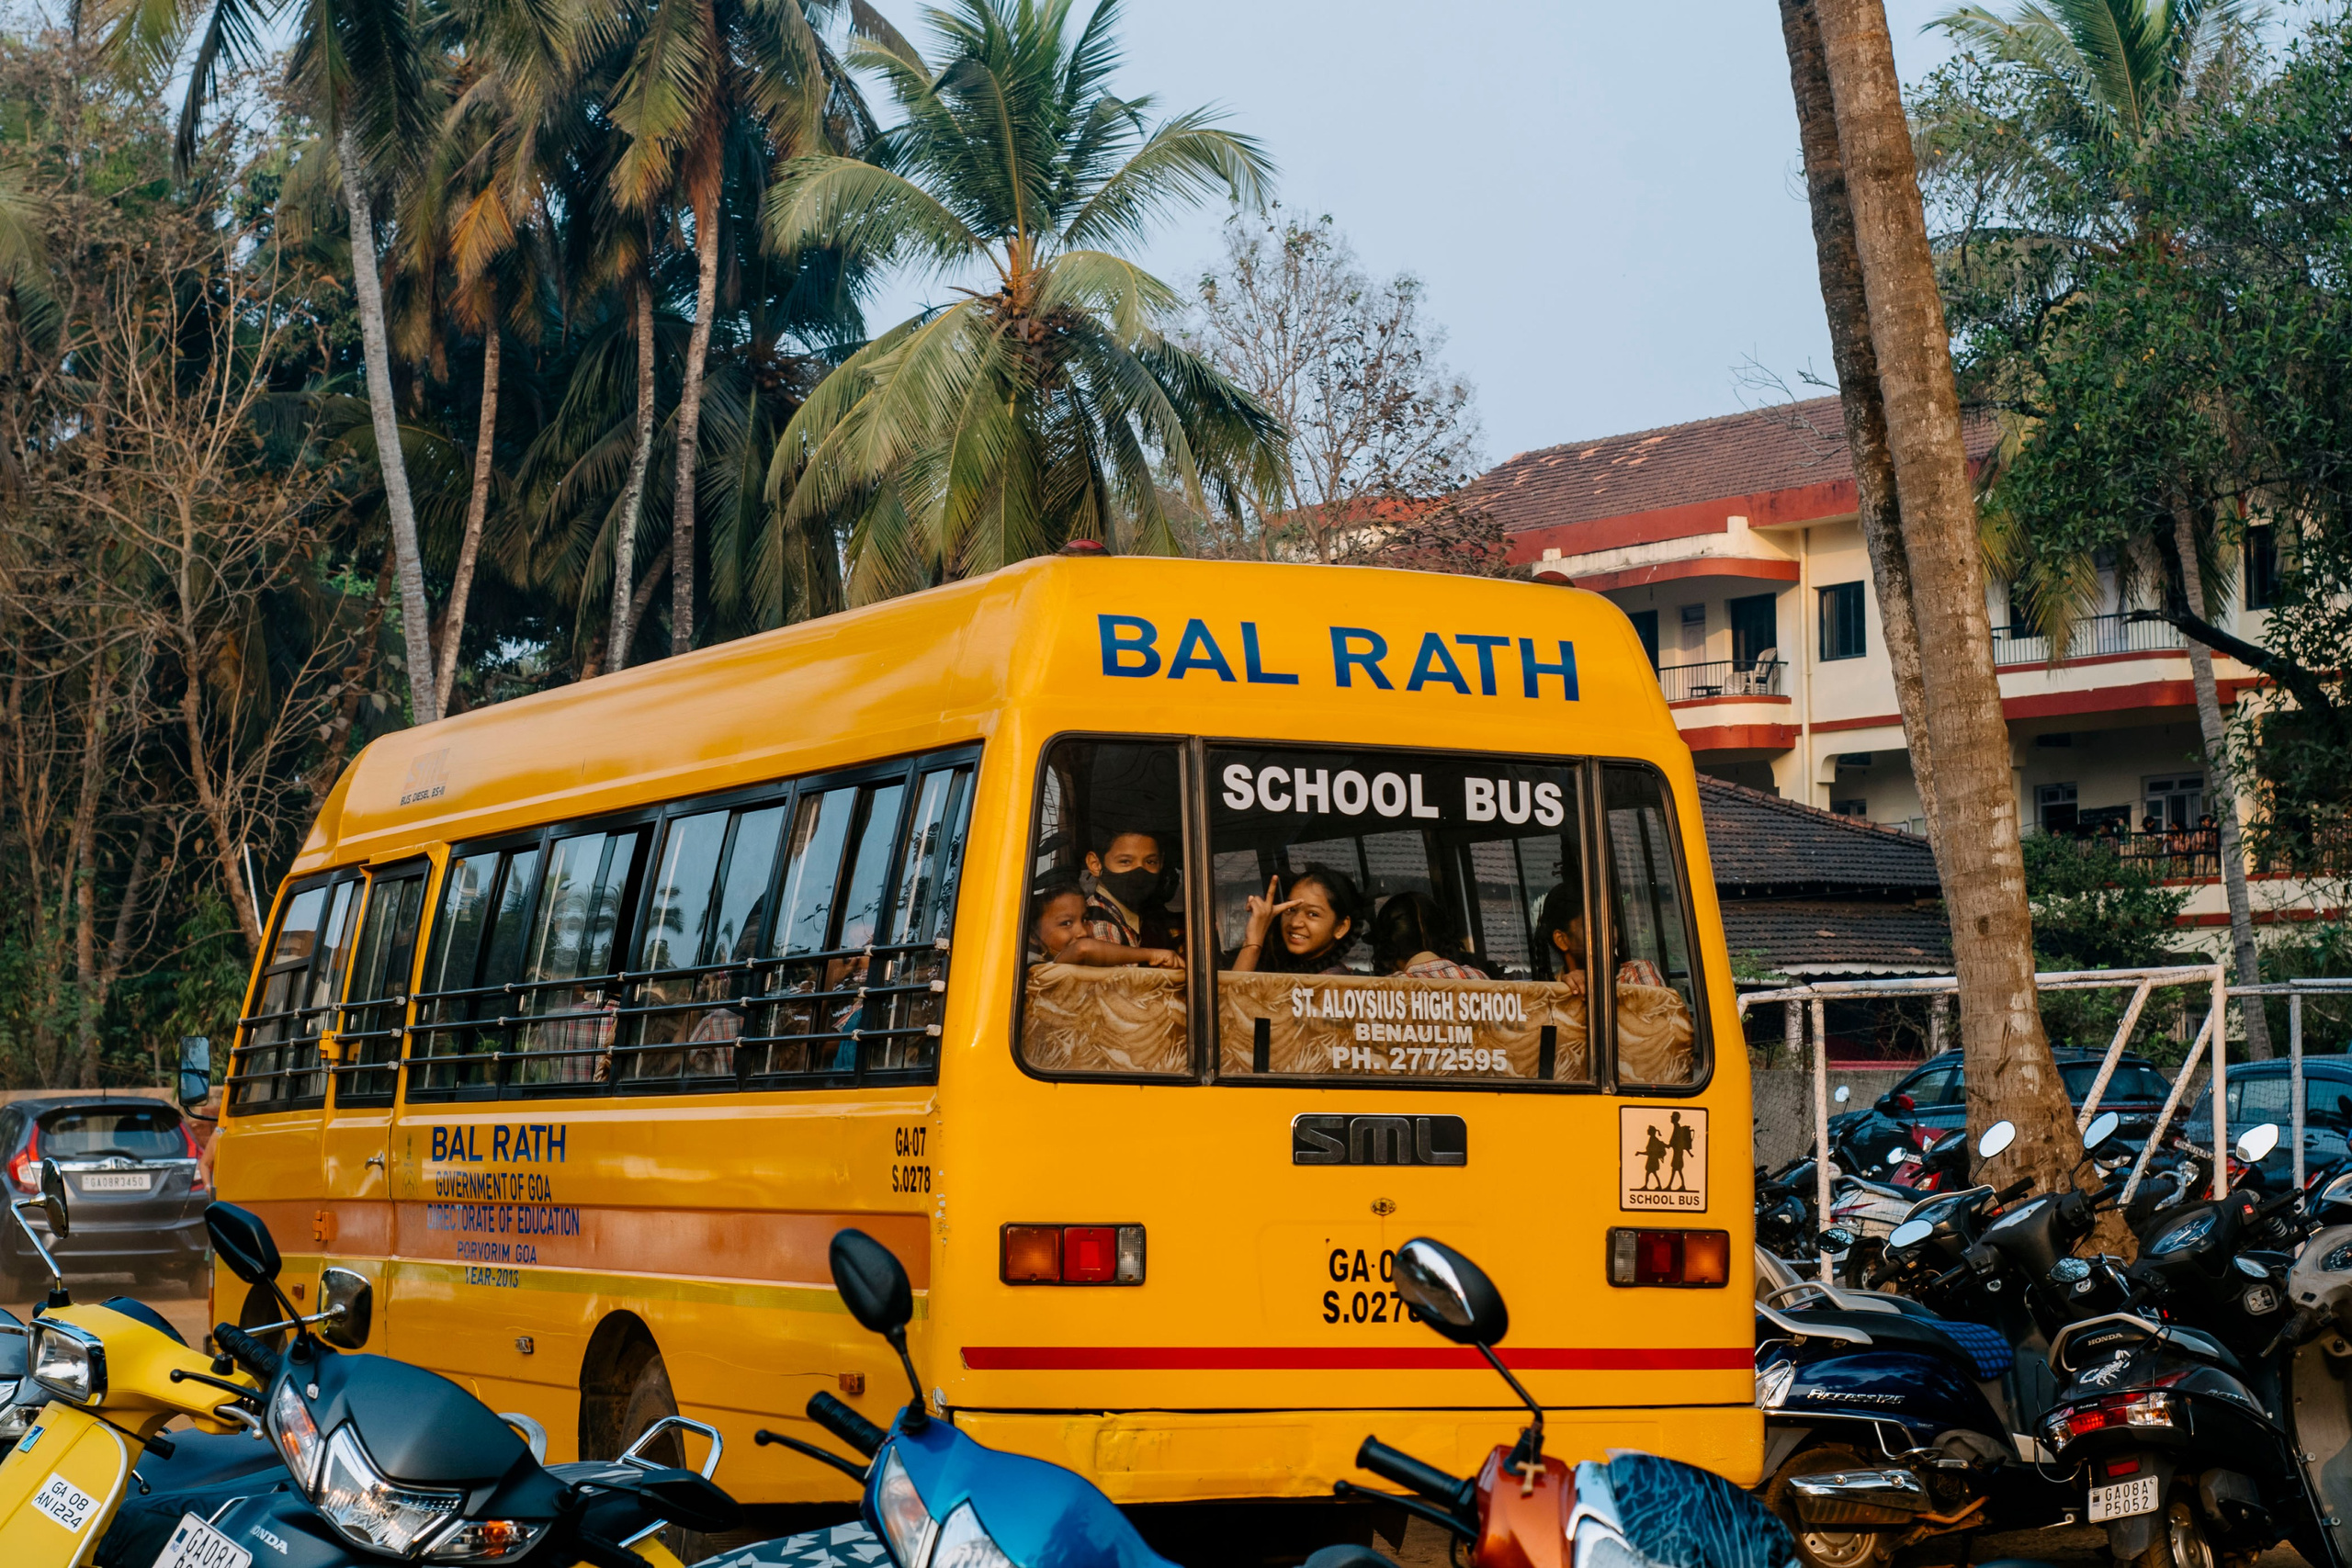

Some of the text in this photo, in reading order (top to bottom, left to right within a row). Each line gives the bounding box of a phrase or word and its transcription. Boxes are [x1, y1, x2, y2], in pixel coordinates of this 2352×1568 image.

[1097, 614, 1580, 702] BAL RATH
[1222, 763, 1565, 827] SCHOOL BUS
[1291, 987, 1527, 1022] ST. ALOYSIUS HIGH SCHOOL
[1355, 1022, 1473, 1043] BENAULIM
[1333, 1046, 1508, 1072] PH. 2772595
[432, 1124, 566, 1163] BAL RATH
[1294, 1116, 1464, 1165] SML
[435, 1171, 552, 1202] GOVERNMENT OF GOA
[892, 1164, 931, 1193] S.0278
[1629, 1194, 1700, 1206] SCHOOL BUS
[426, 1203, 580, 1236] DIRECTORATE OF EDUCATION
[457, 1240, 537, 1264] PORVORIM GOA
[465, 1267, 519, 1288] YEAR-2013
[2087, 1332, 2123, 1347] HONDA
[51, 1481, 89, 1511] GA 08
[2105, 1480, 2149, 1502] GA08A
[2105, 1495, 2149, 1517] P5052
[34, 1492, 83, 1529] AN1224
[250, 1525, 288, 1555] ONDA
